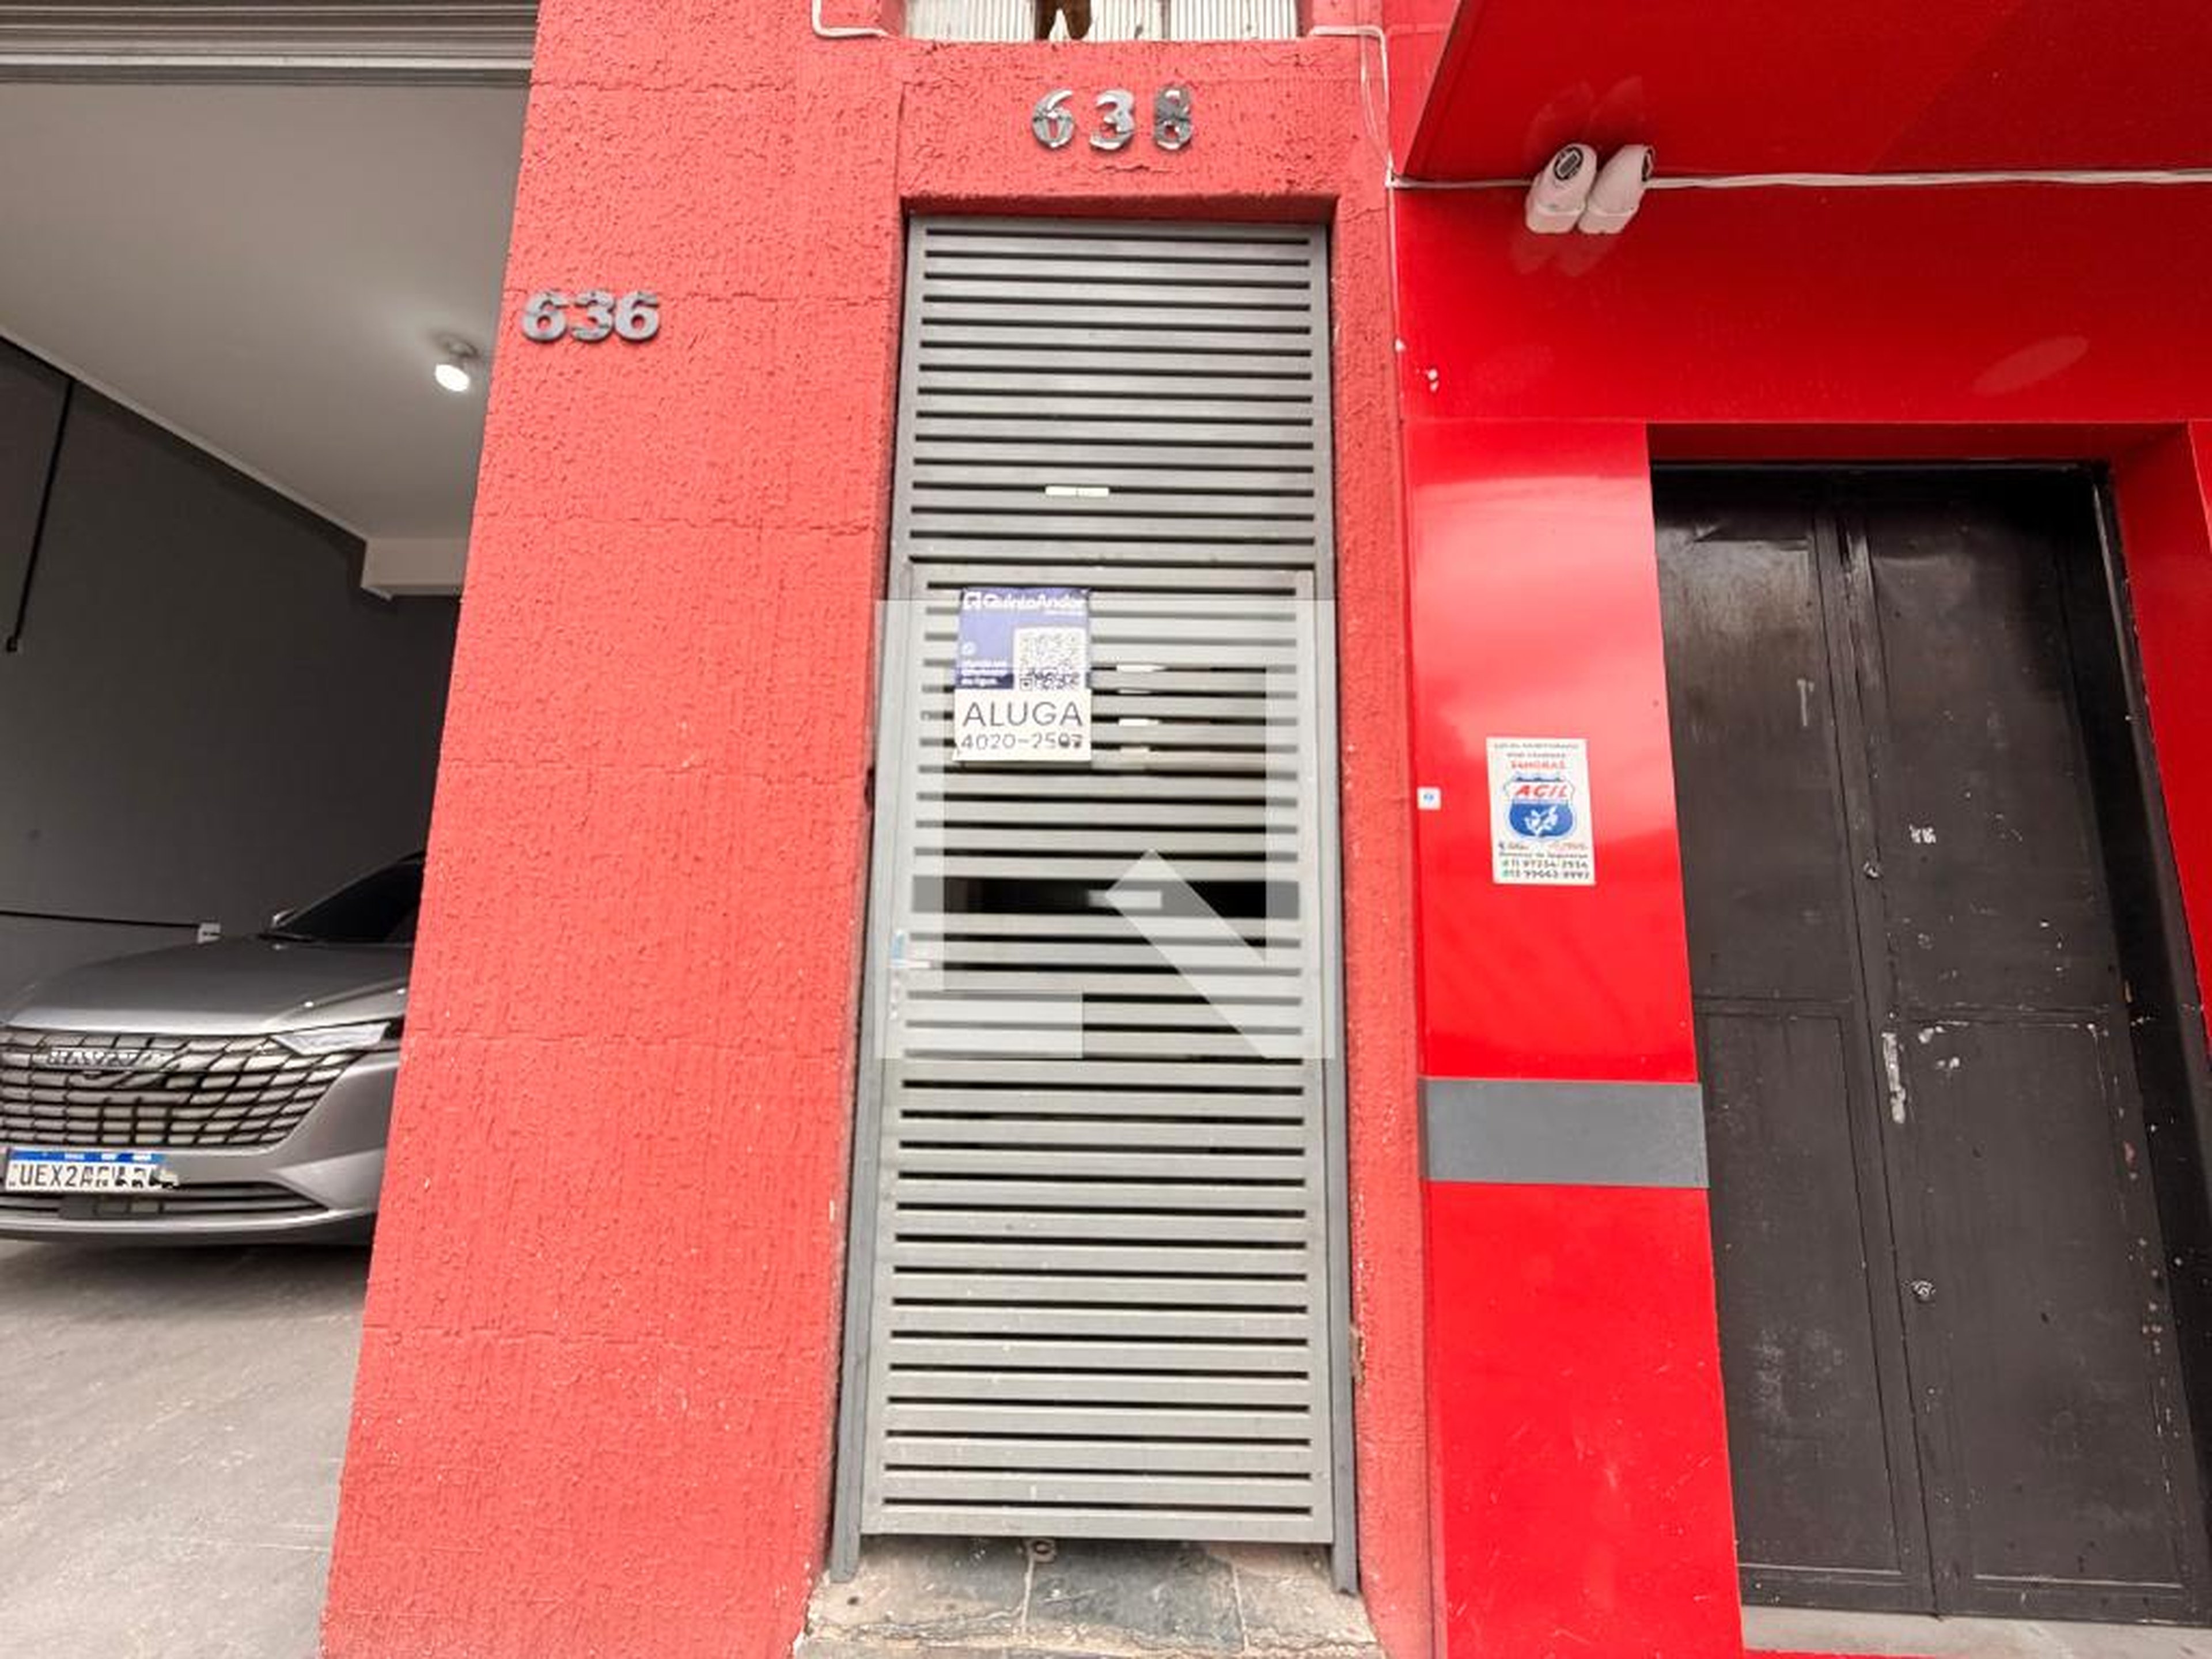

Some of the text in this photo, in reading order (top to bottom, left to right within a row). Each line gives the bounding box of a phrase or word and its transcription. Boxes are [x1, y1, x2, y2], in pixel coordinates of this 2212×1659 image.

[1032, 85, 1192, 150] 638
[521, 290, 660, 343] 636
[963, 701, 1083, 726] ALUGA
